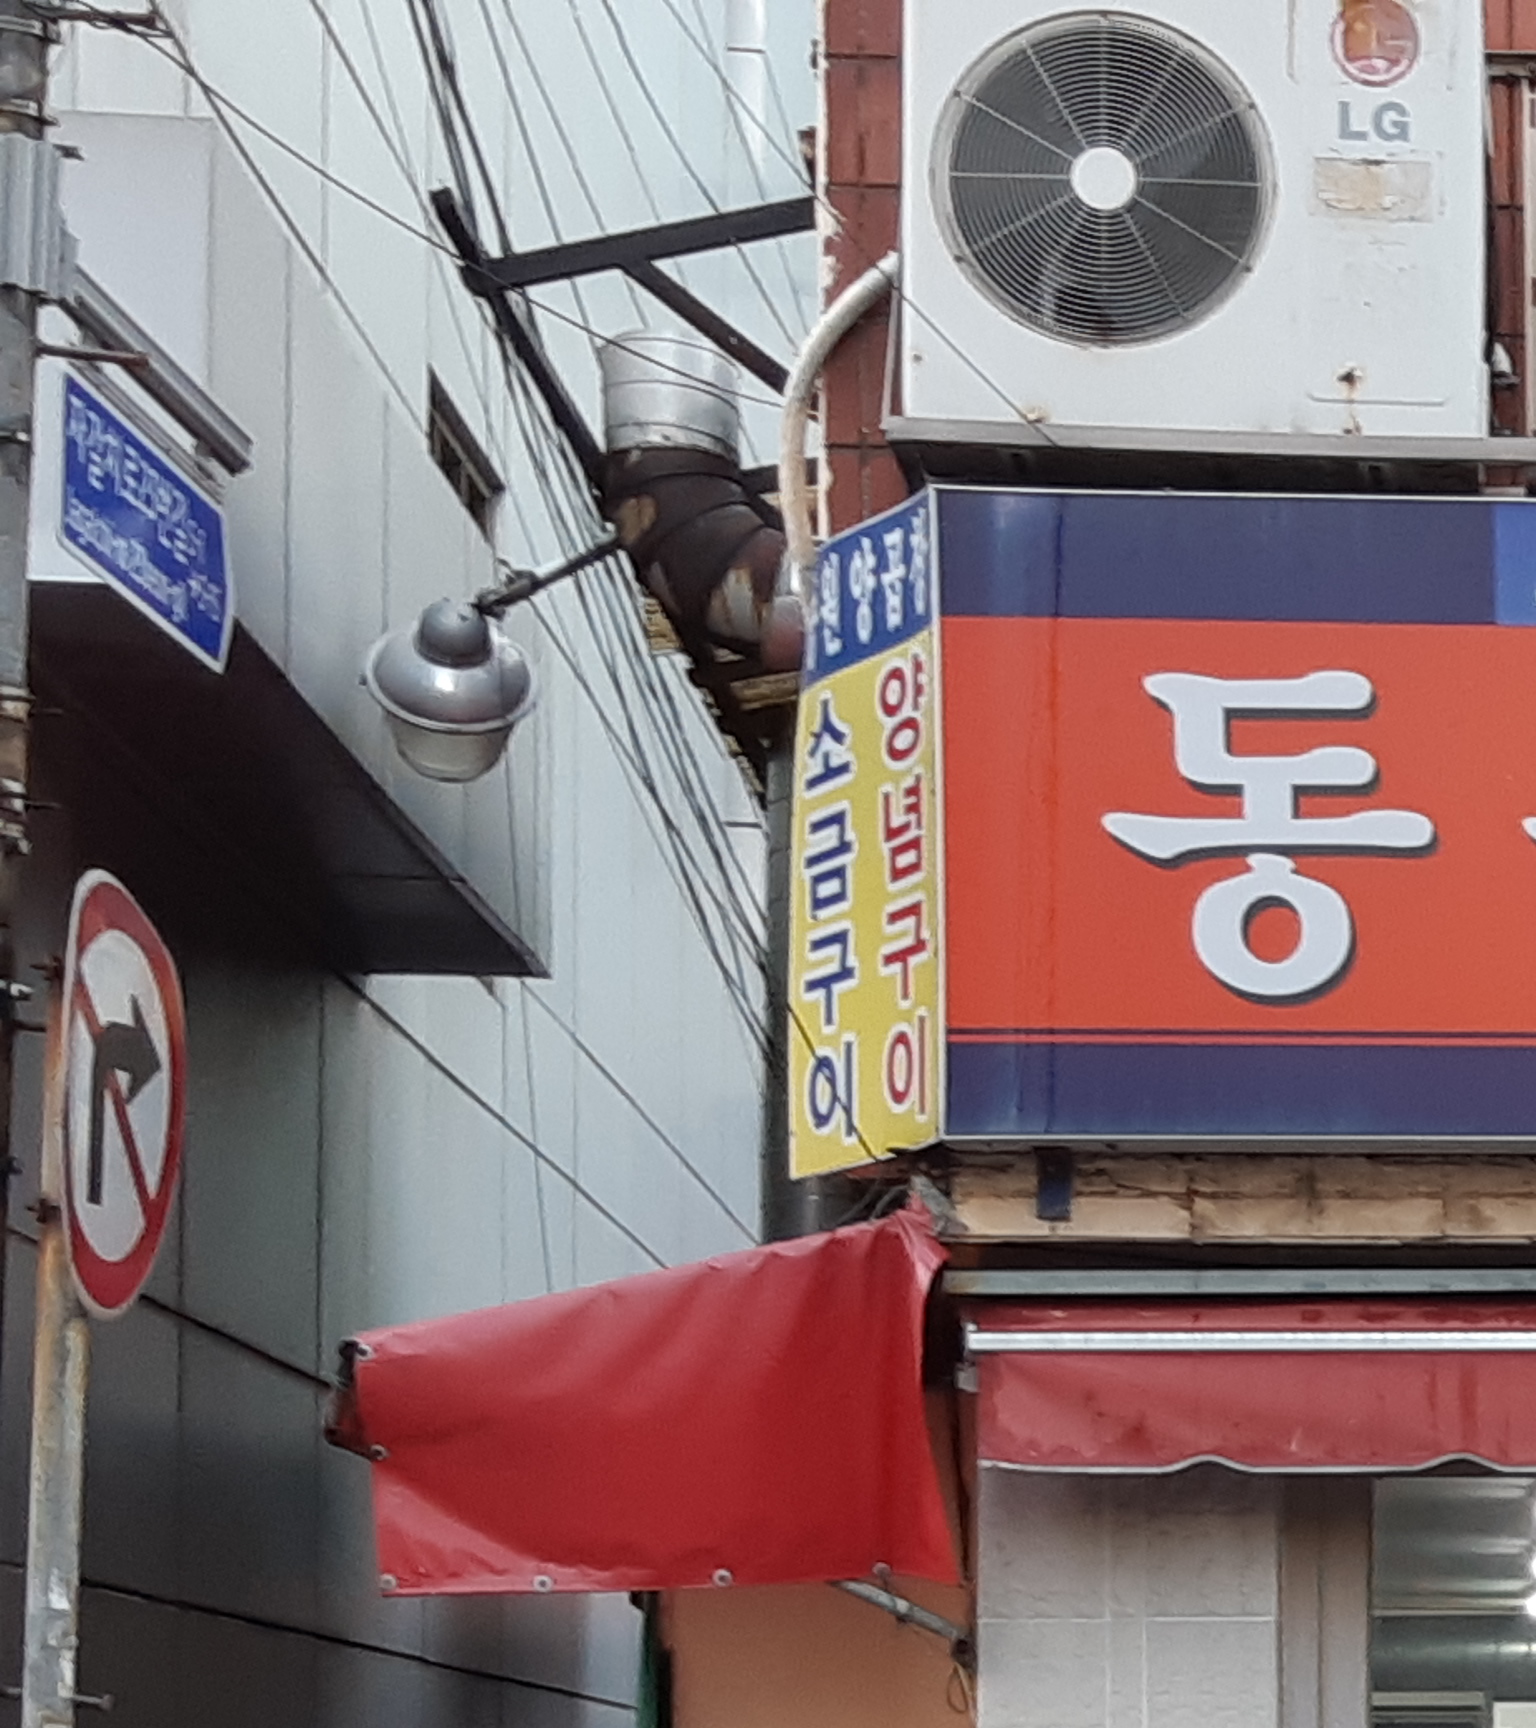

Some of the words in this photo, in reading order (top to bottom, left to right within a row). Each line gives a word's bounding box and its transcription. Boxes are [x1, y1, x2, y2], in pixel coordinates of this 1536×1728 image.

[1338, 100, 1412, 143] LG
[803, 695, 859, 1140] 소금구이
[878, 650, 928, 1121] 양념구이
